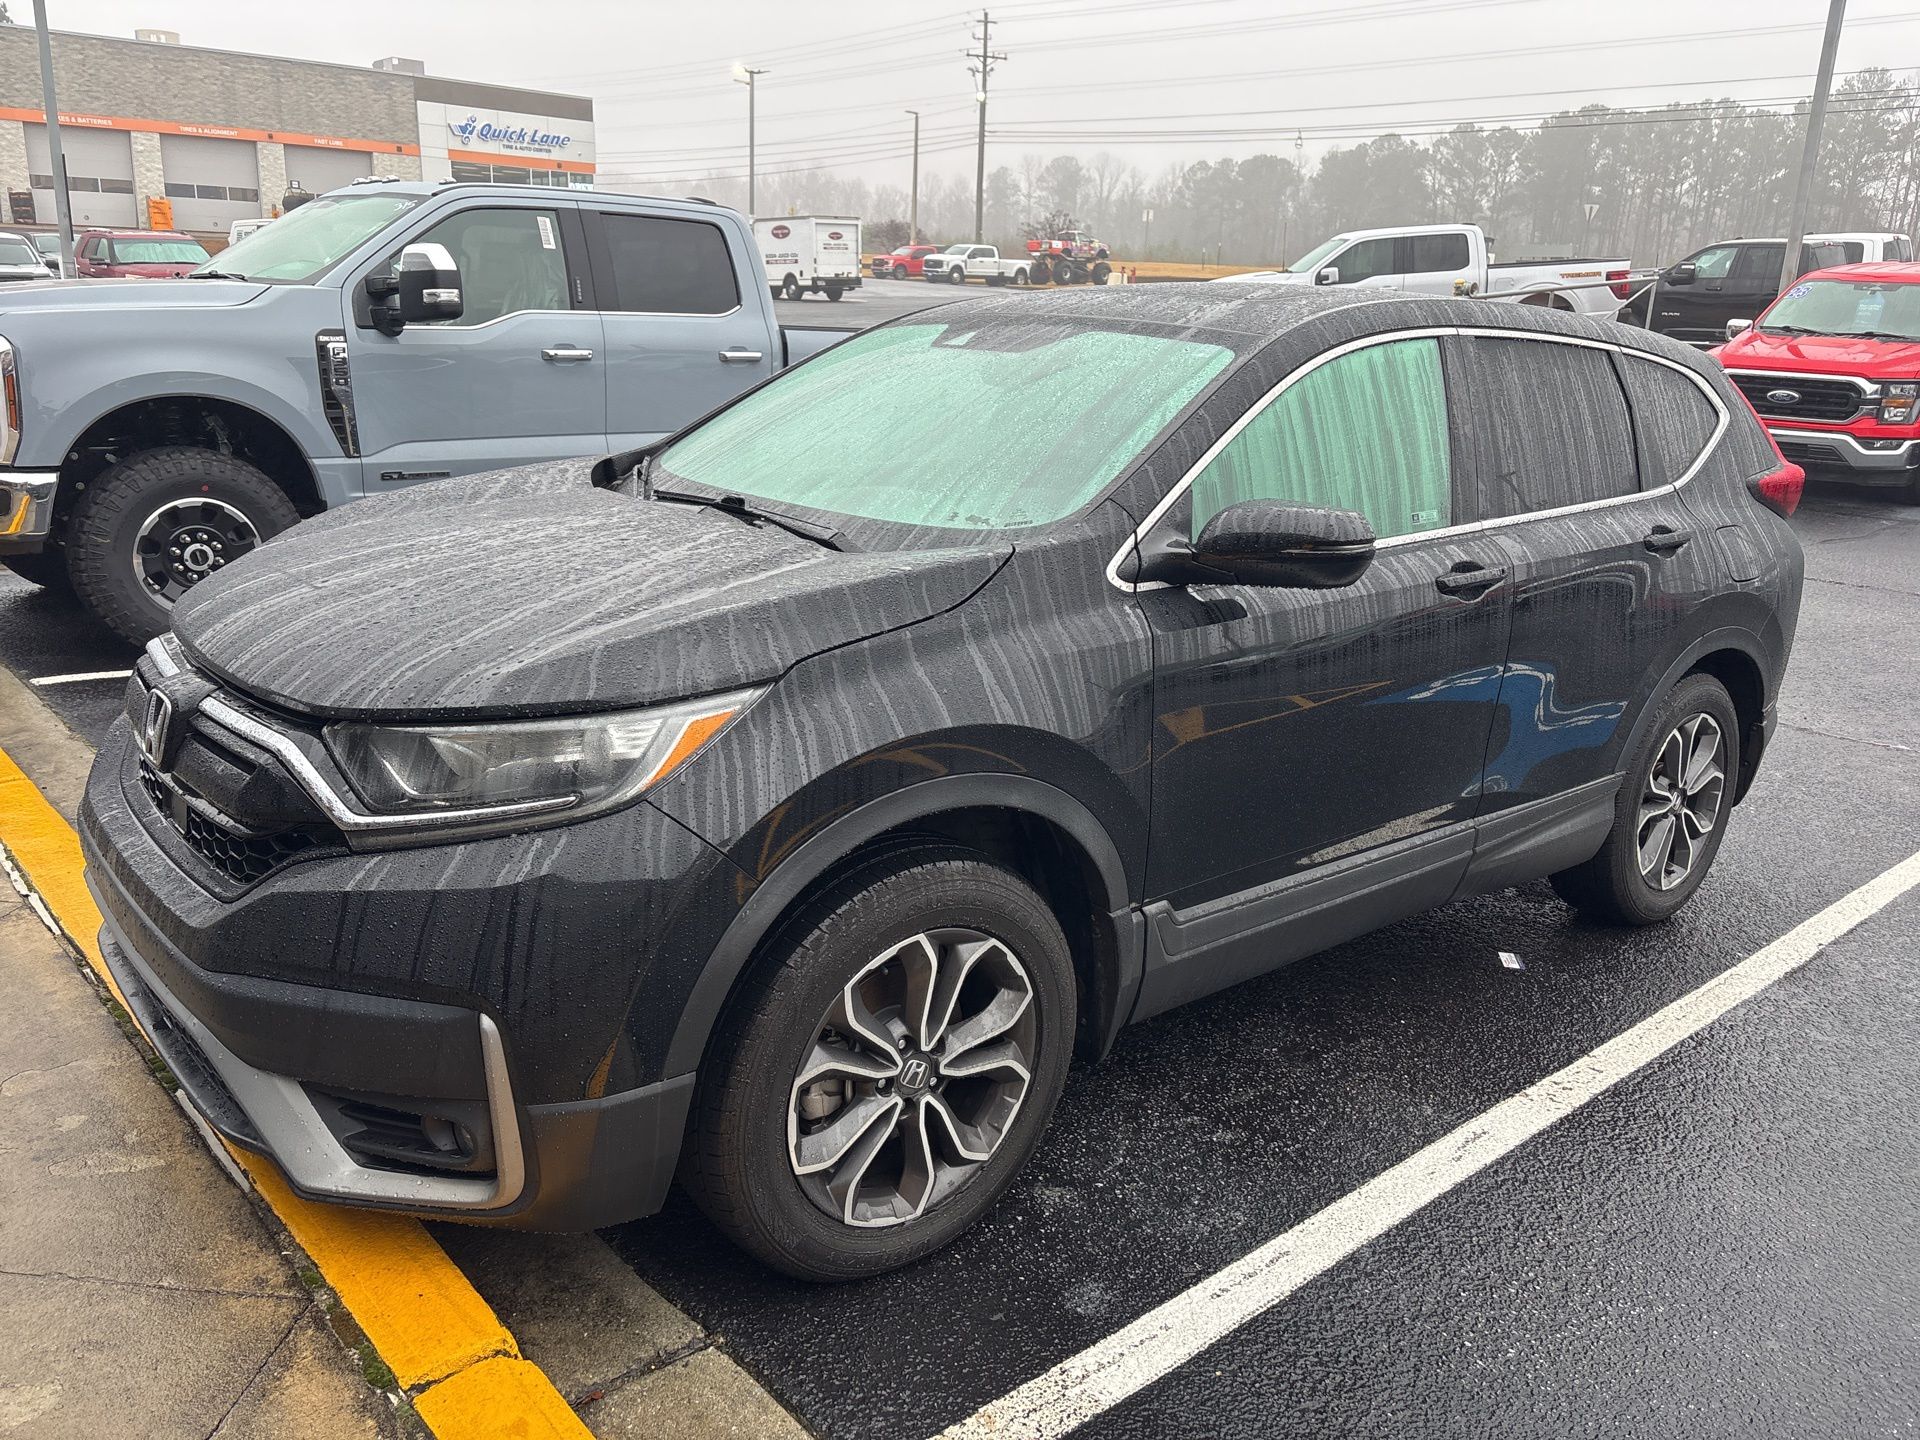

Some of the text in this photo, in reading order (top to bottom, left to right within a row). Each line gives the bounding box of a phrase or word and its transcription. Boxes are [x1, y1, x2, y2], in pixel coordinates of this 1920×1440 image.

[77, 117, 113, 125] BATTERIES
[203, 128, 239, 136] ALIGNMENT
[479, 123, 571, 148] Quick Lane
[1559, 271, 1602, 279] TREMOR
[1773, 392, 1791, 401] Ford
